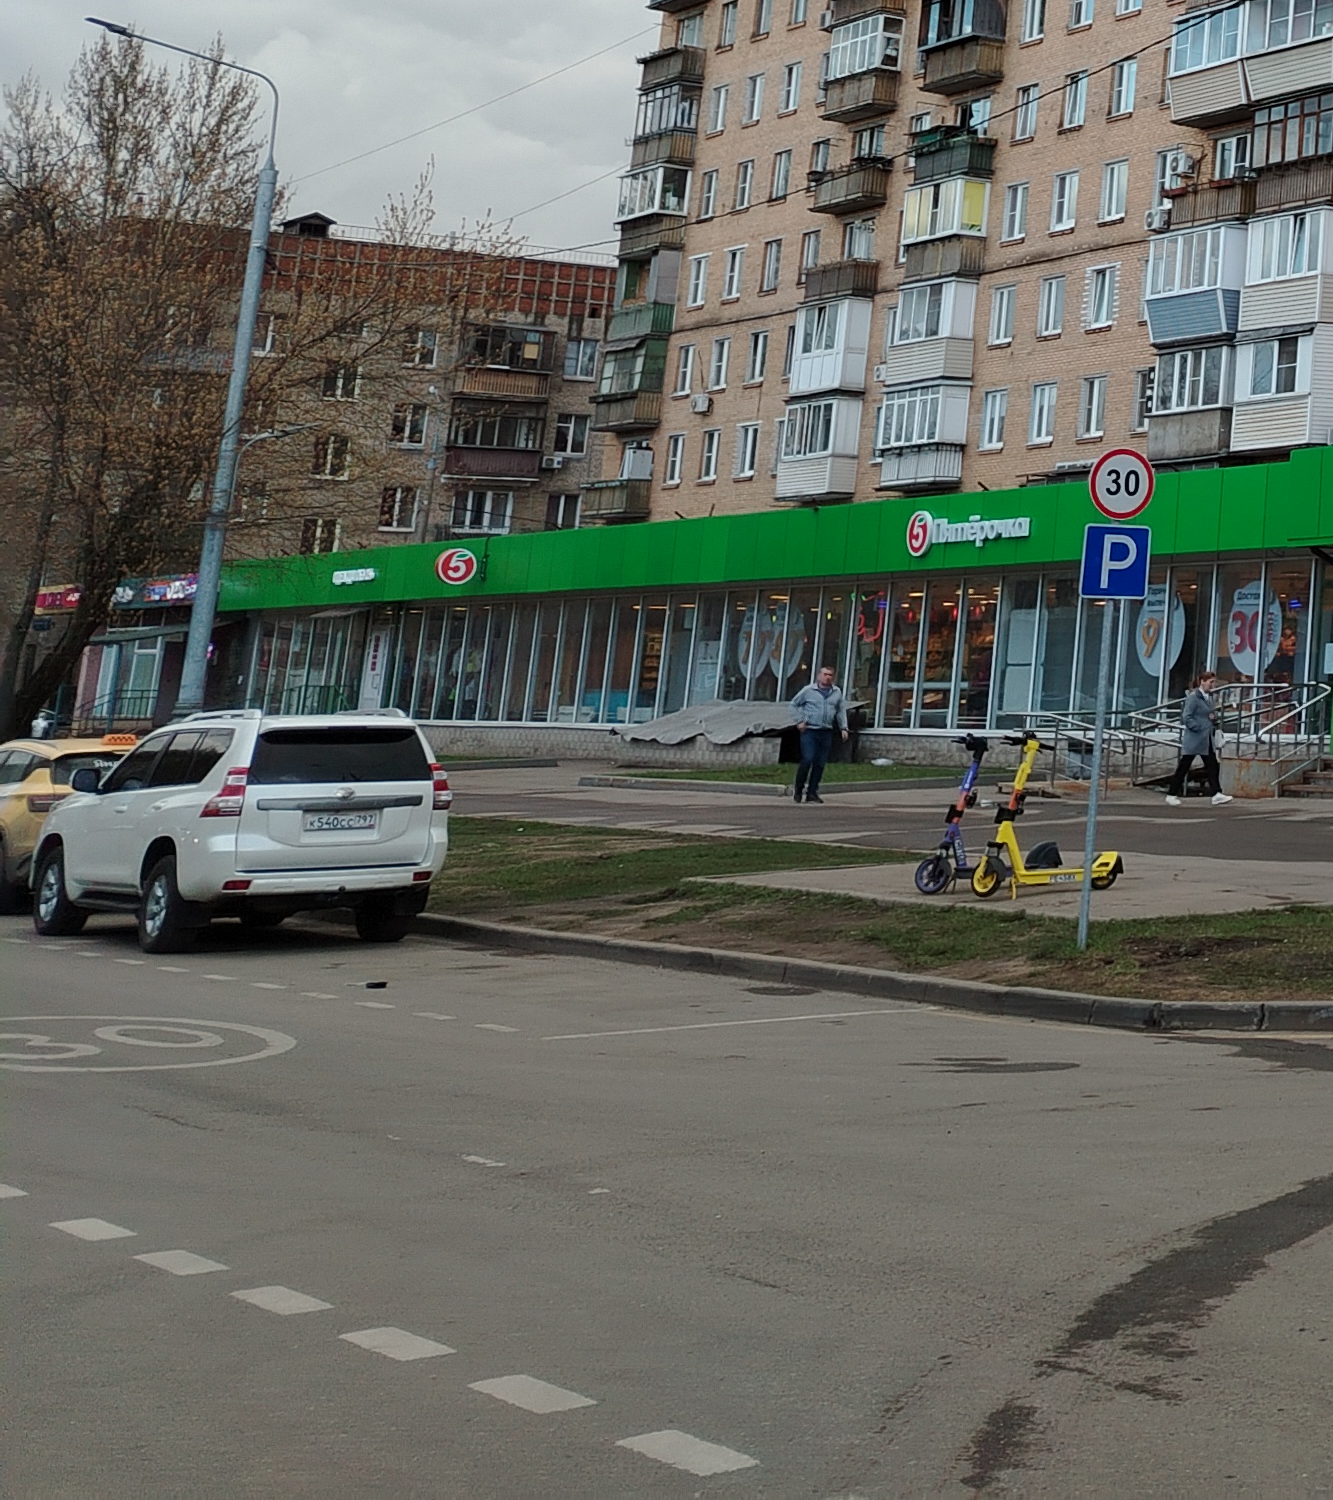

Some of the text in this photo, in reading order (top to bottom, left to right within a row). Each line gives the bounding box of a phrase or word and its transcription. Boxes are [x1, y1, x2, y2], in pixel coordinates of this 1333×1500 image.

[1105, 469, 1140, 496] 30
[931, 515, 1030, 547] Пятёрочка
[1100, 534, 1137, 588] P
